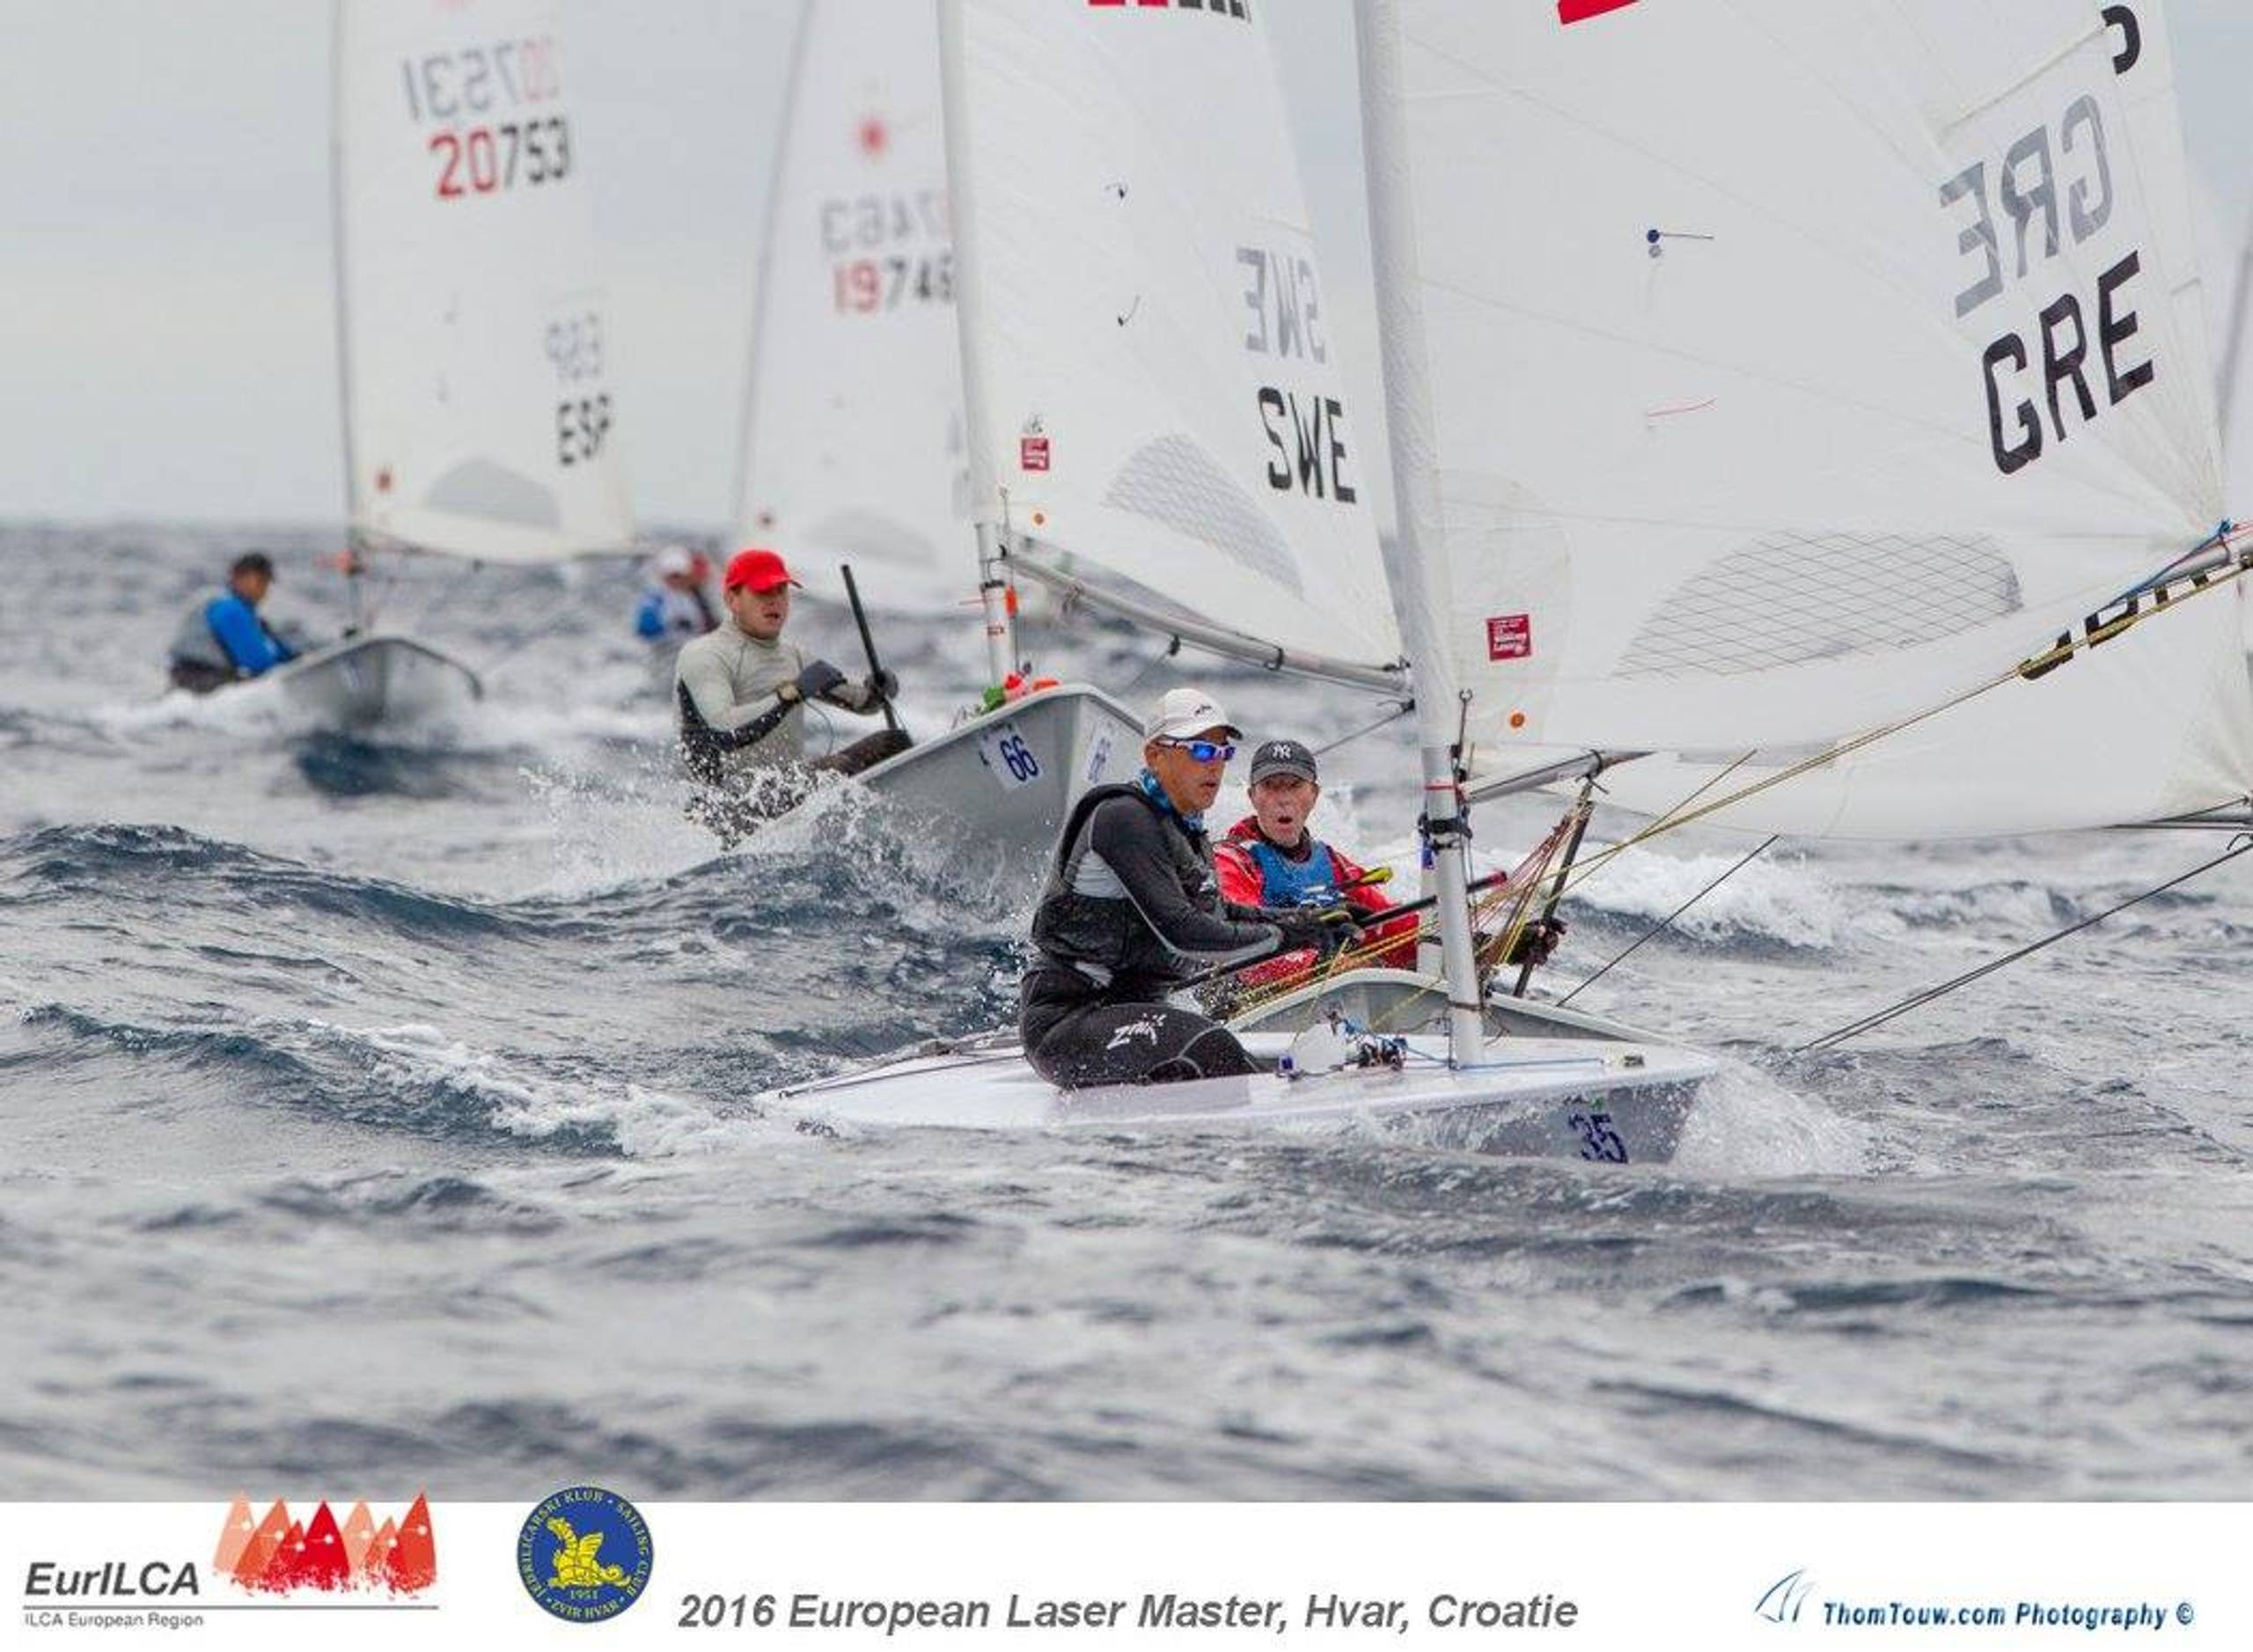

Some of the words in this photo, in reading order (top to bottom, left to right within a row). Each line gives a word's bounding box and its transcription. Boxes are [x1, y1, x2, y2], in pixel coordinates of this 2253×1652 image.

[1984, 250, 2153, 474] GRE
[555, 393, 611, 466] ESP
[1258, 387, 1356, 503] SWE
[1000, 735, 1039, 782] 66
